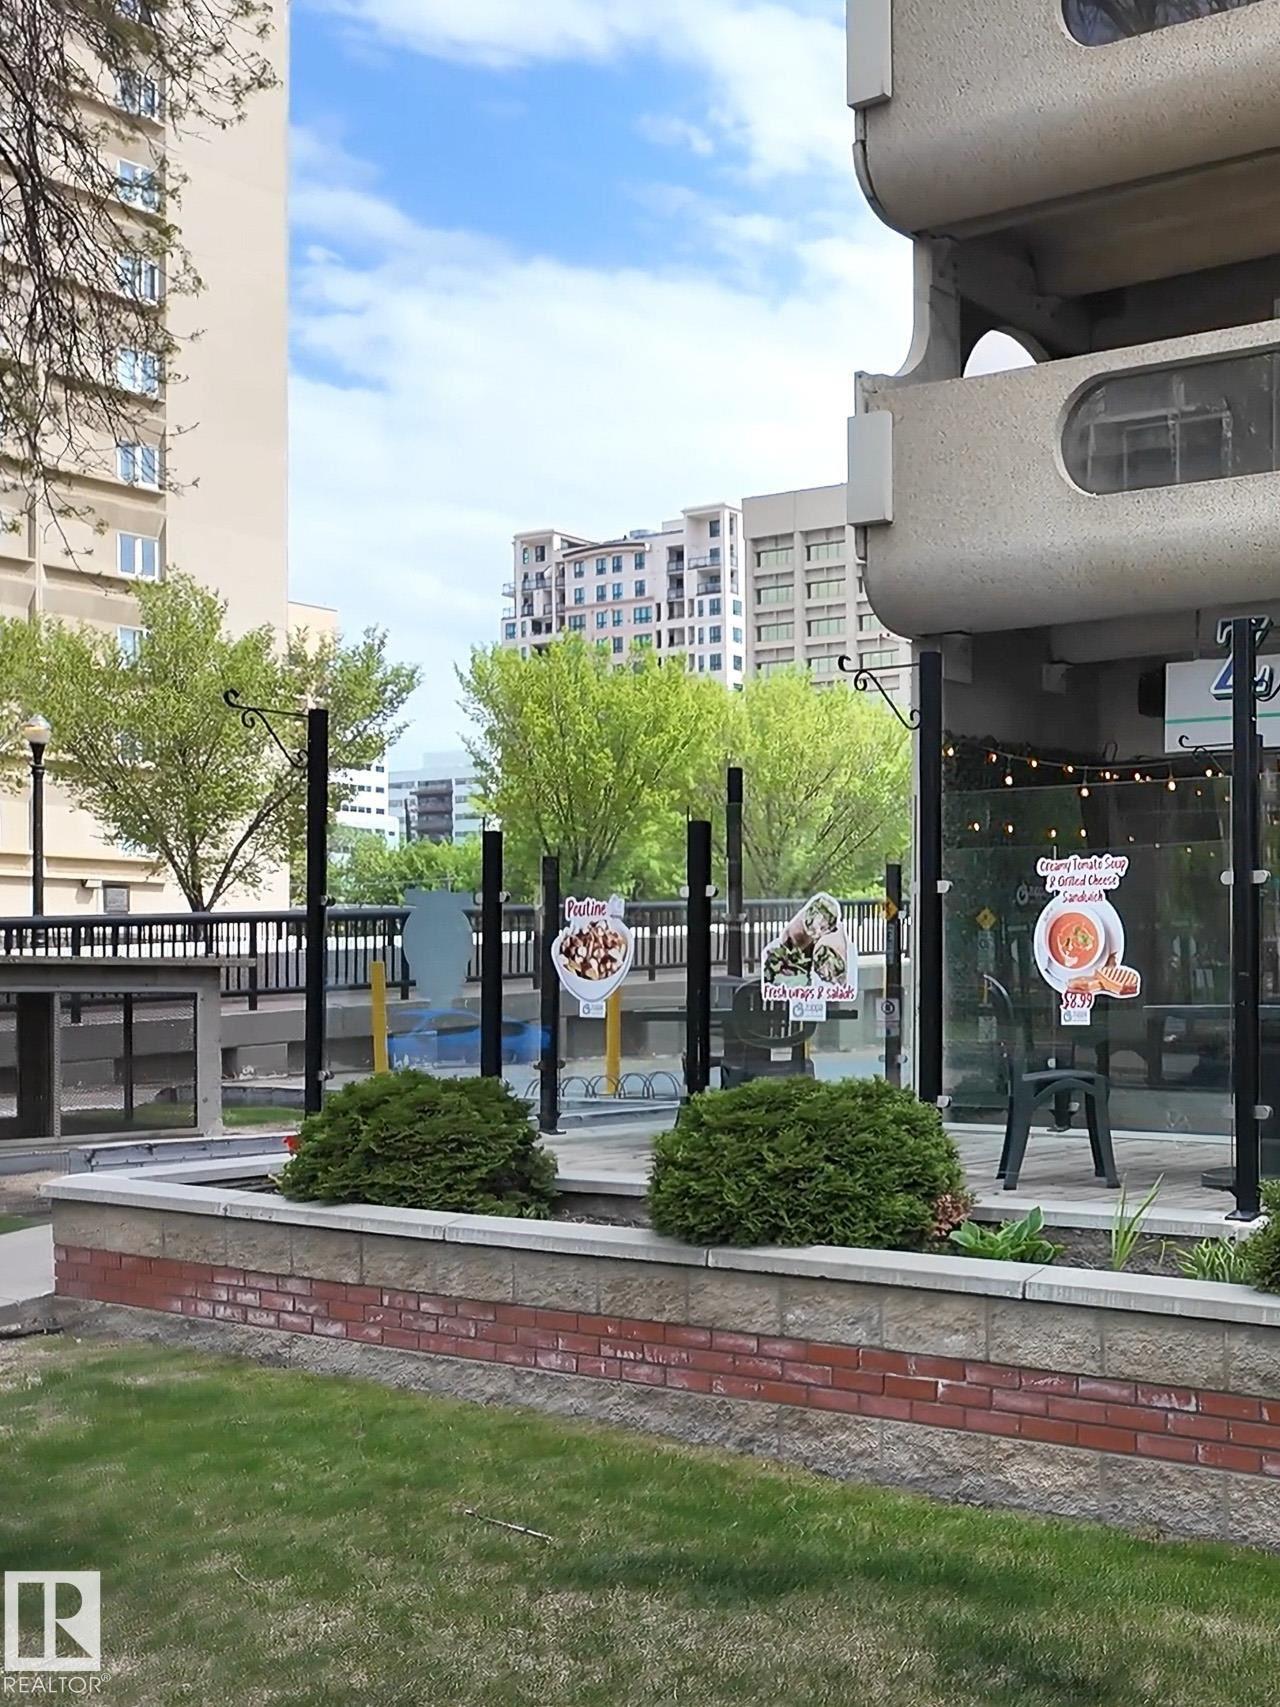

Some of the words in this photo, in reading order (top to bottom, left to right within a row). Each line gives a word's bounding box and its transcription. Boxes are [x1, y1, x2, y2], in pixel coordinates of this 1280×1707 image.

[1040, 860, 1071, 873] Creamy
[1072, 857, 1103, 870] Tomato
[1104, 856, 1126, 872] Soup
[1058, 874, 1086, 886] Grilled
[1088, 874, 1117, 886] Cheese
[567, 899, 607, 918] Poutine
[763, 984, 787, 999] Fresh
[788, 987, 815, 1002] wraps
[826, 984, 855, 999] salads
[1062, 990, 1093, 1009] $8.99
